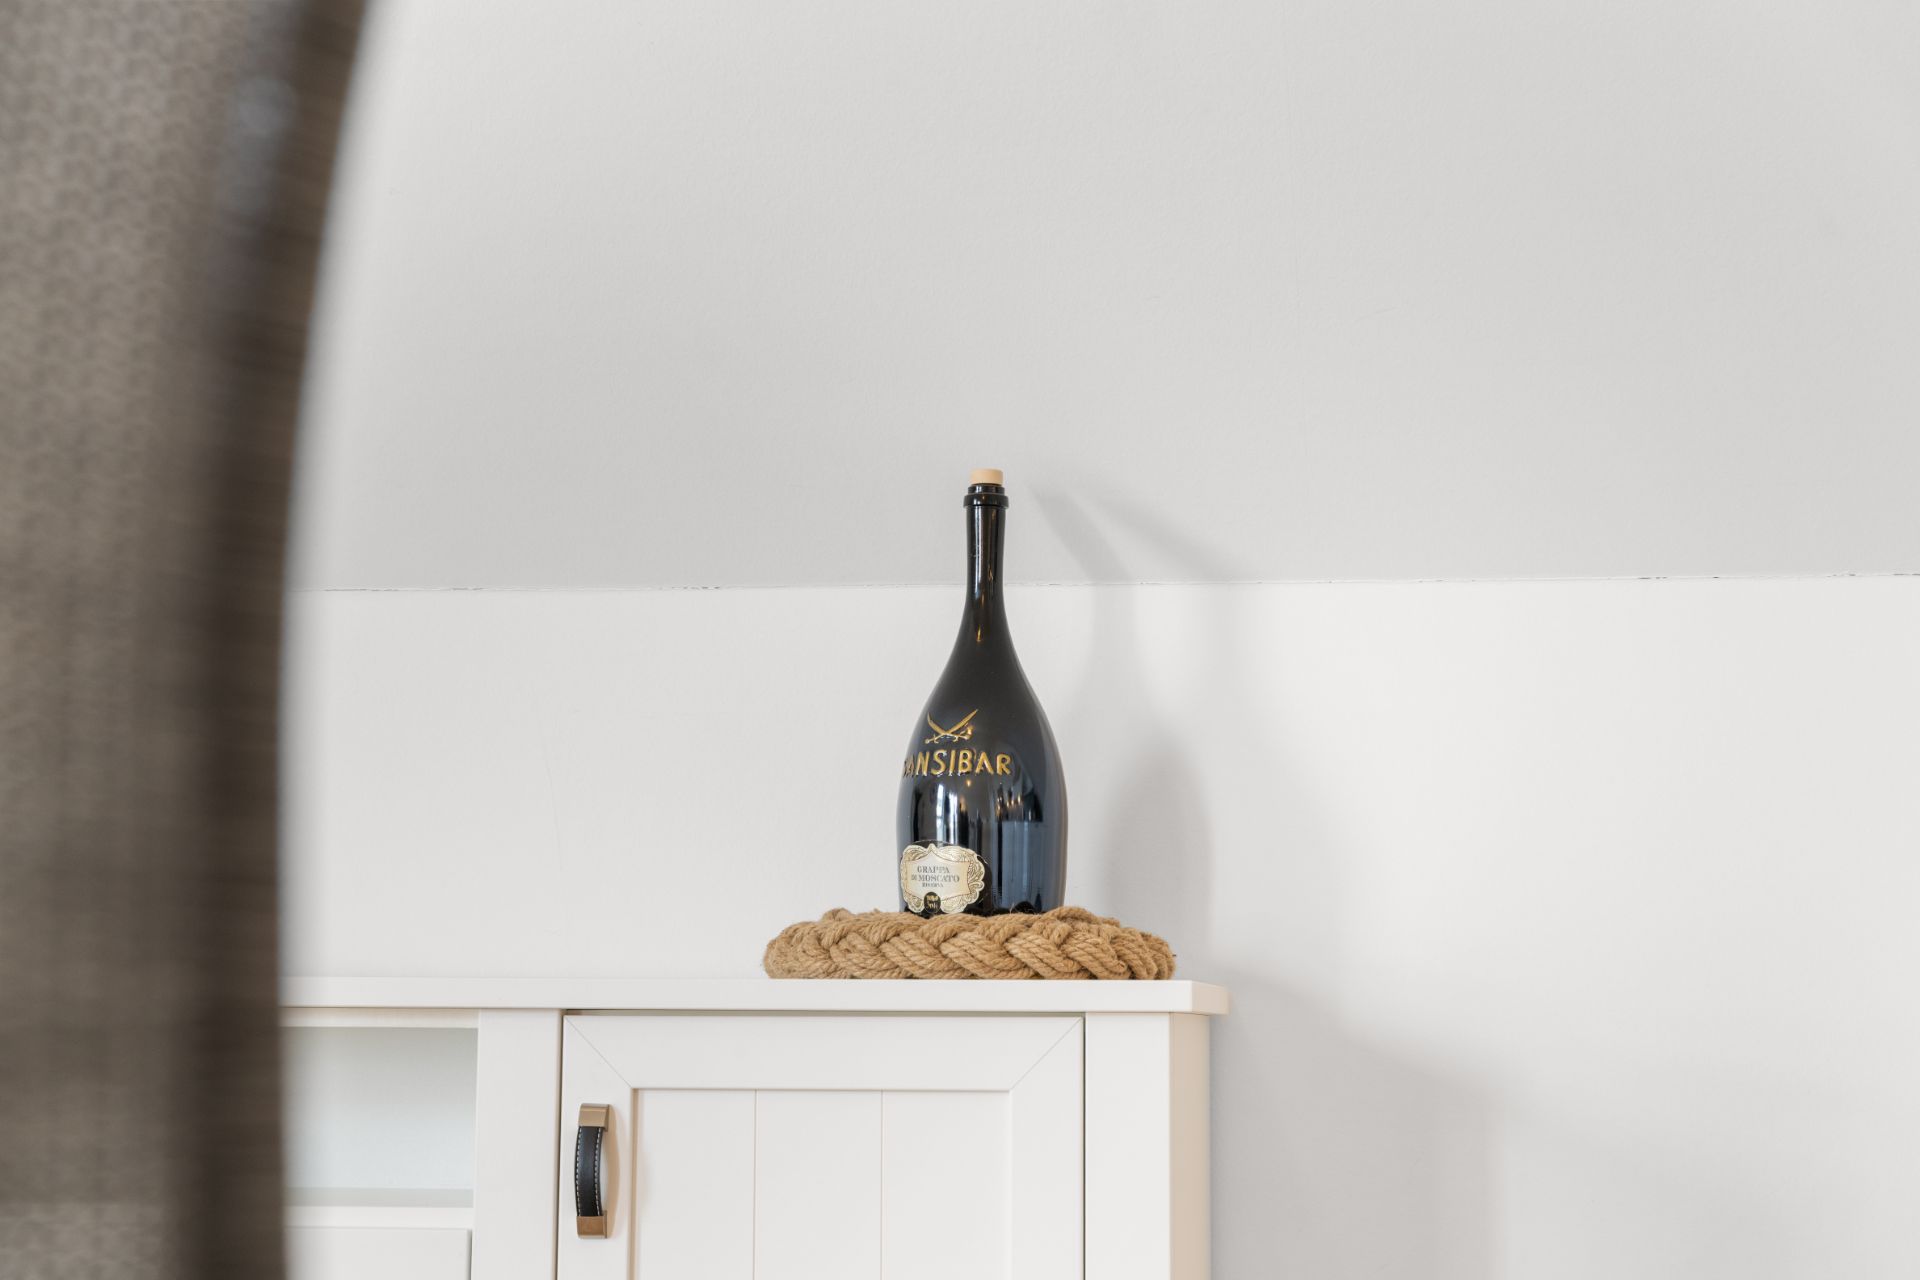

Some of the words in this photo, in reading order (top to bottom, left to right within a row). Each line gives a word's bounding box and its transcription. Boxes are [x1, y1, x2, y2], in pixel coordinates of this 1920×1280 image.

[903, 749, 1011, 777] ANSIBAR
[917, 865, 950, 874] GRAPPA
[918, 874, 960, 883] MOSCATO
